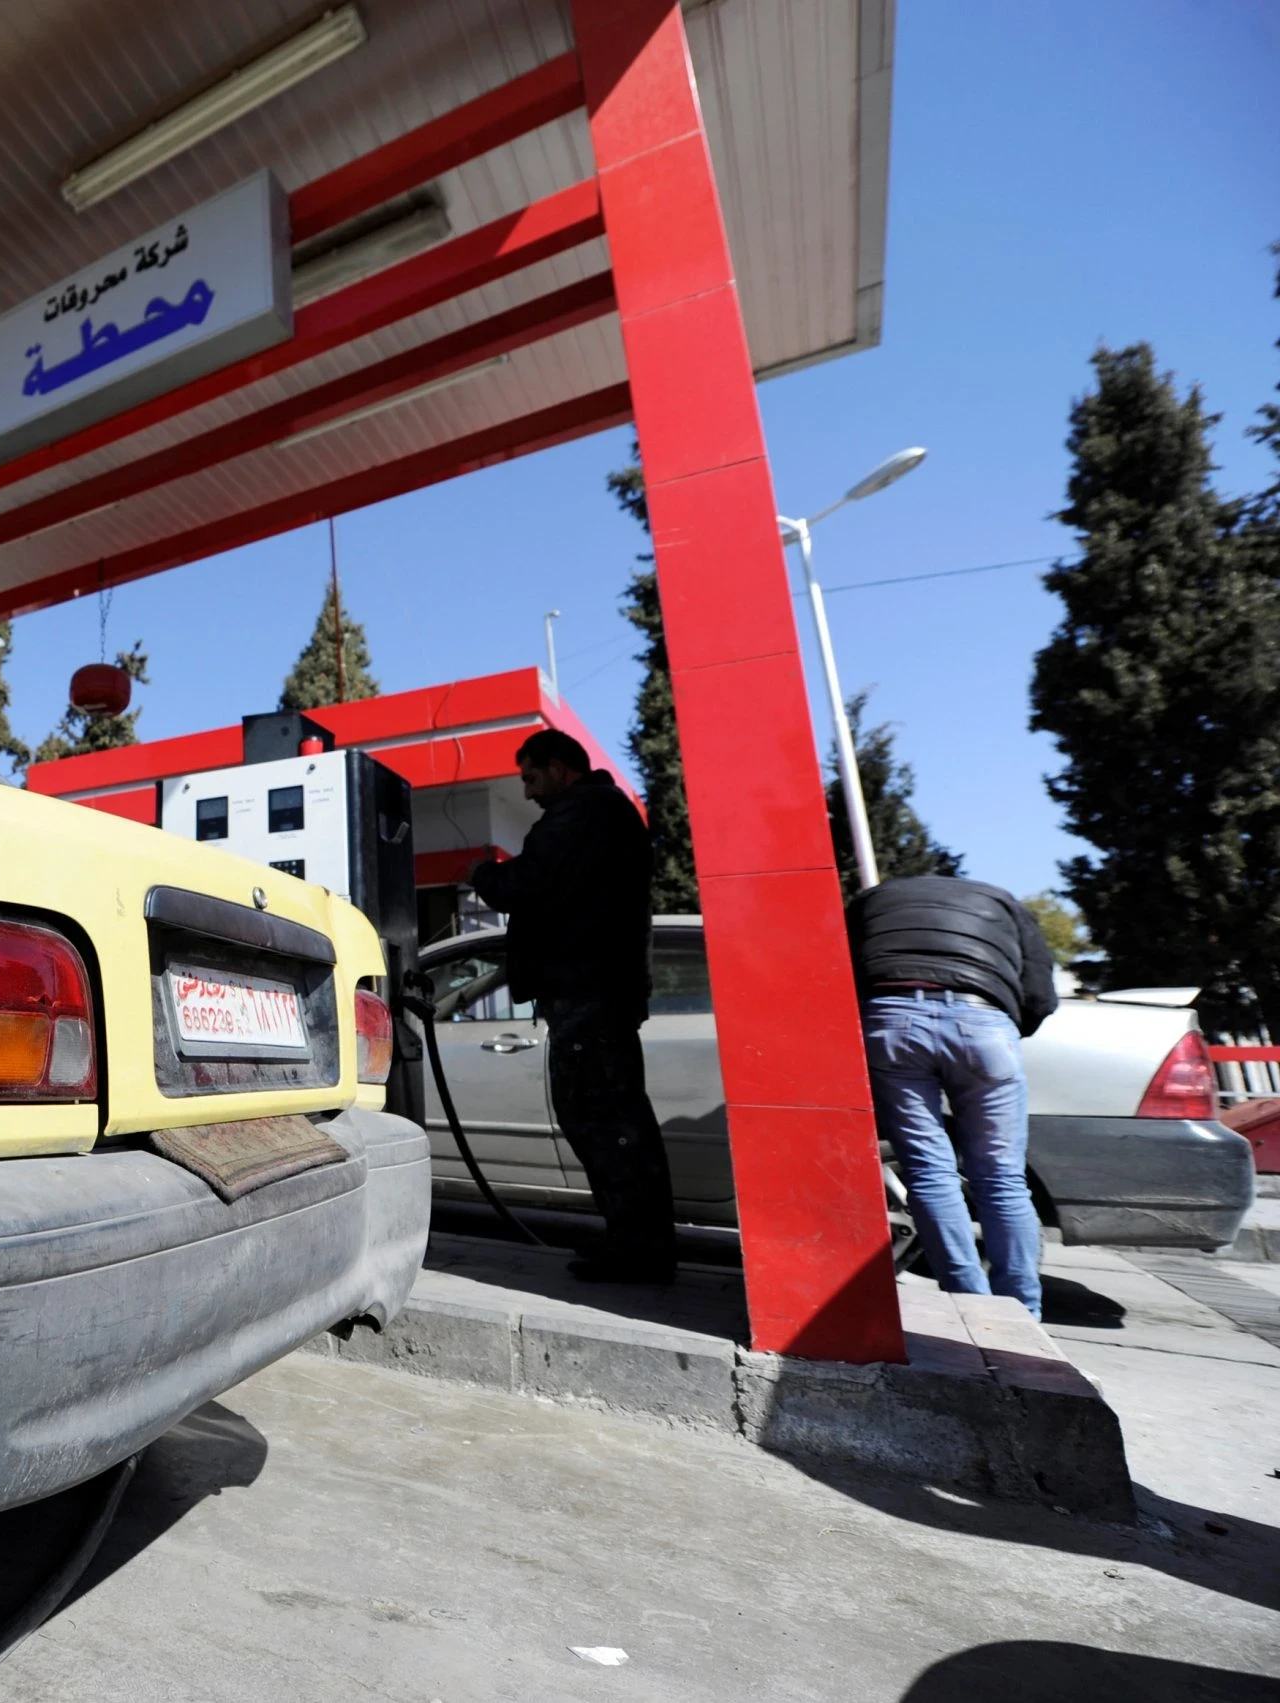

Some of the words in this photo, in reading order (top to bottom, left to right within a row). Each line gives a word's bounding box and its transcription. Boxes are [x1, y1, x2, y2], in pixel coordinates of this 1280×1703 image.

[135, 224, 189, 273] شركة
[43, 266, 128, 323] محروقات
[22, 278, 215, 397] محطة
